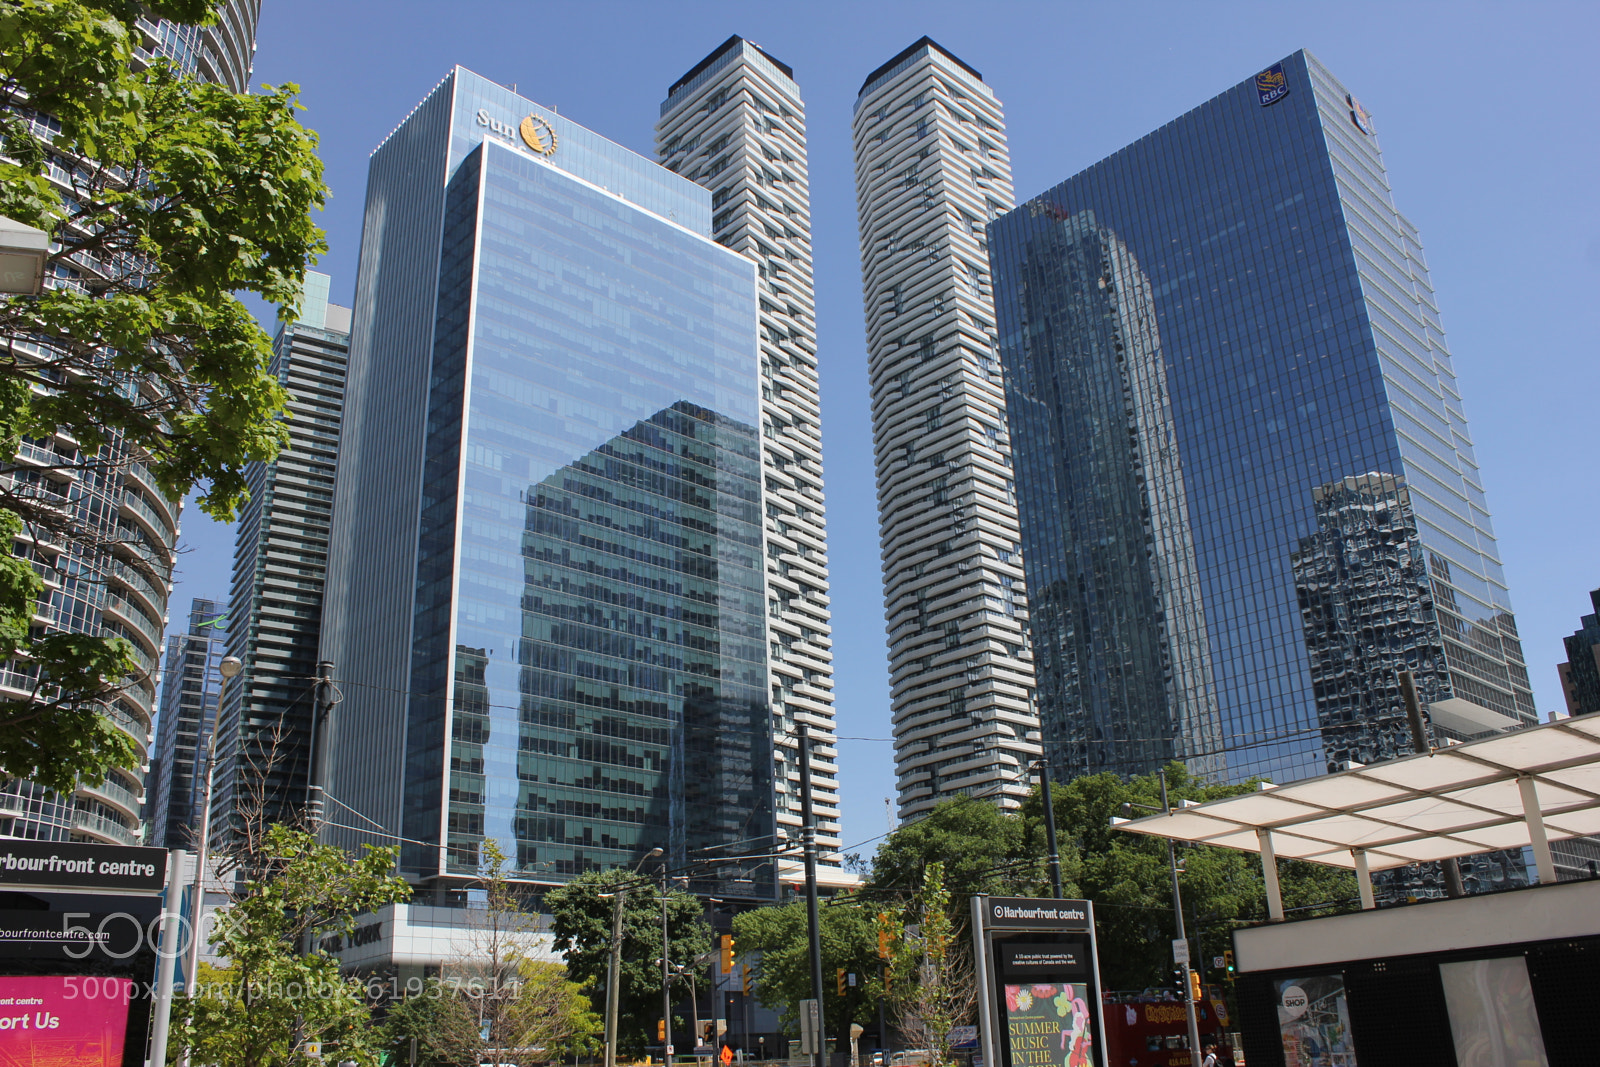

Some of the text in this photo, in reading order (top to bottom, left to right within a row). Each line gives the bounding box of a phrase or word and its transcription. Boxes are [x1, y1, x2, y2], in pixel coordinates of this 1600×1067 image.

[1262, 85, 1286, 103] RBC
[476, 108, 517, 141] Sun
[99, 860, 155, 876] centre
[1003, 906, 1085, 920] Harbourfront centre
[0, 928, 110, 940] bourfrontcentre.com
[346, 921, 382, 948] YORK
[16, 997, 43, 1005] centre
[1285, 999, 1305, 1008] SHOP
[0, 1012, 60, 1030] ort Us
[1009, 1021, 1061, 1036] SUMMER
[1010, 1036, 1049, 1050] MUSIC
[1012, 1050, 1052, 1065] IN THE
